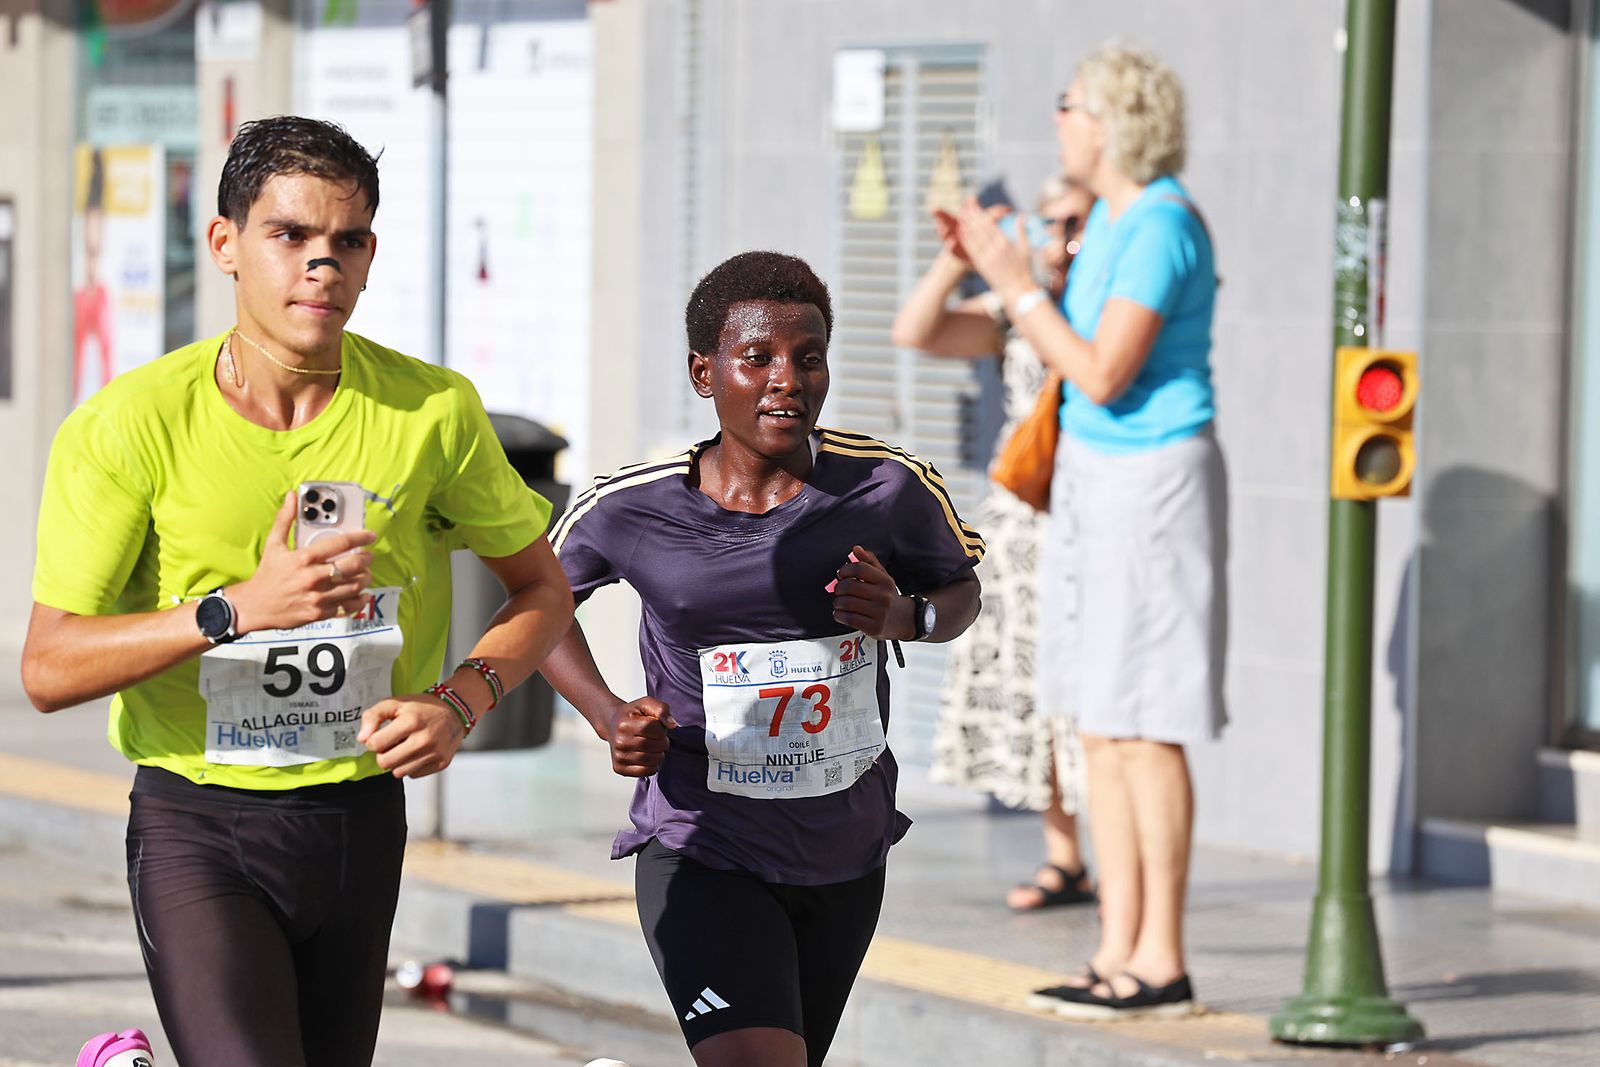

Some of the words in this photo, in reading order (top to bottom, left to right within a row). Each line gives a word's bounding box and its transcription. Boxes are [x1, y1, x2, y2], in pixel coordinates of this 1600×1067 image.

[839, 634, 866, 662] 21K
[262, 643, 346, 698] 59
[713, 651, 750, 675] 21K
[791, 665, 823, 674] HUELVA
[715, 674, 751, 684] HUELVA
[289, 701, 320, 709] ISMAEL
[758, 683, 832, 738] 73
[241, 712, 319, 731] ALLAGUI
[325, 706, 362, 723] DIEZ
[217, 725, 298, 749] Huelva
[788, 740, 810, 749] ODILE
[766, 748, 826, 767] NINTIJE
[717, 762, 794, 784] Huelva
[766, 785, 794, 793] original
